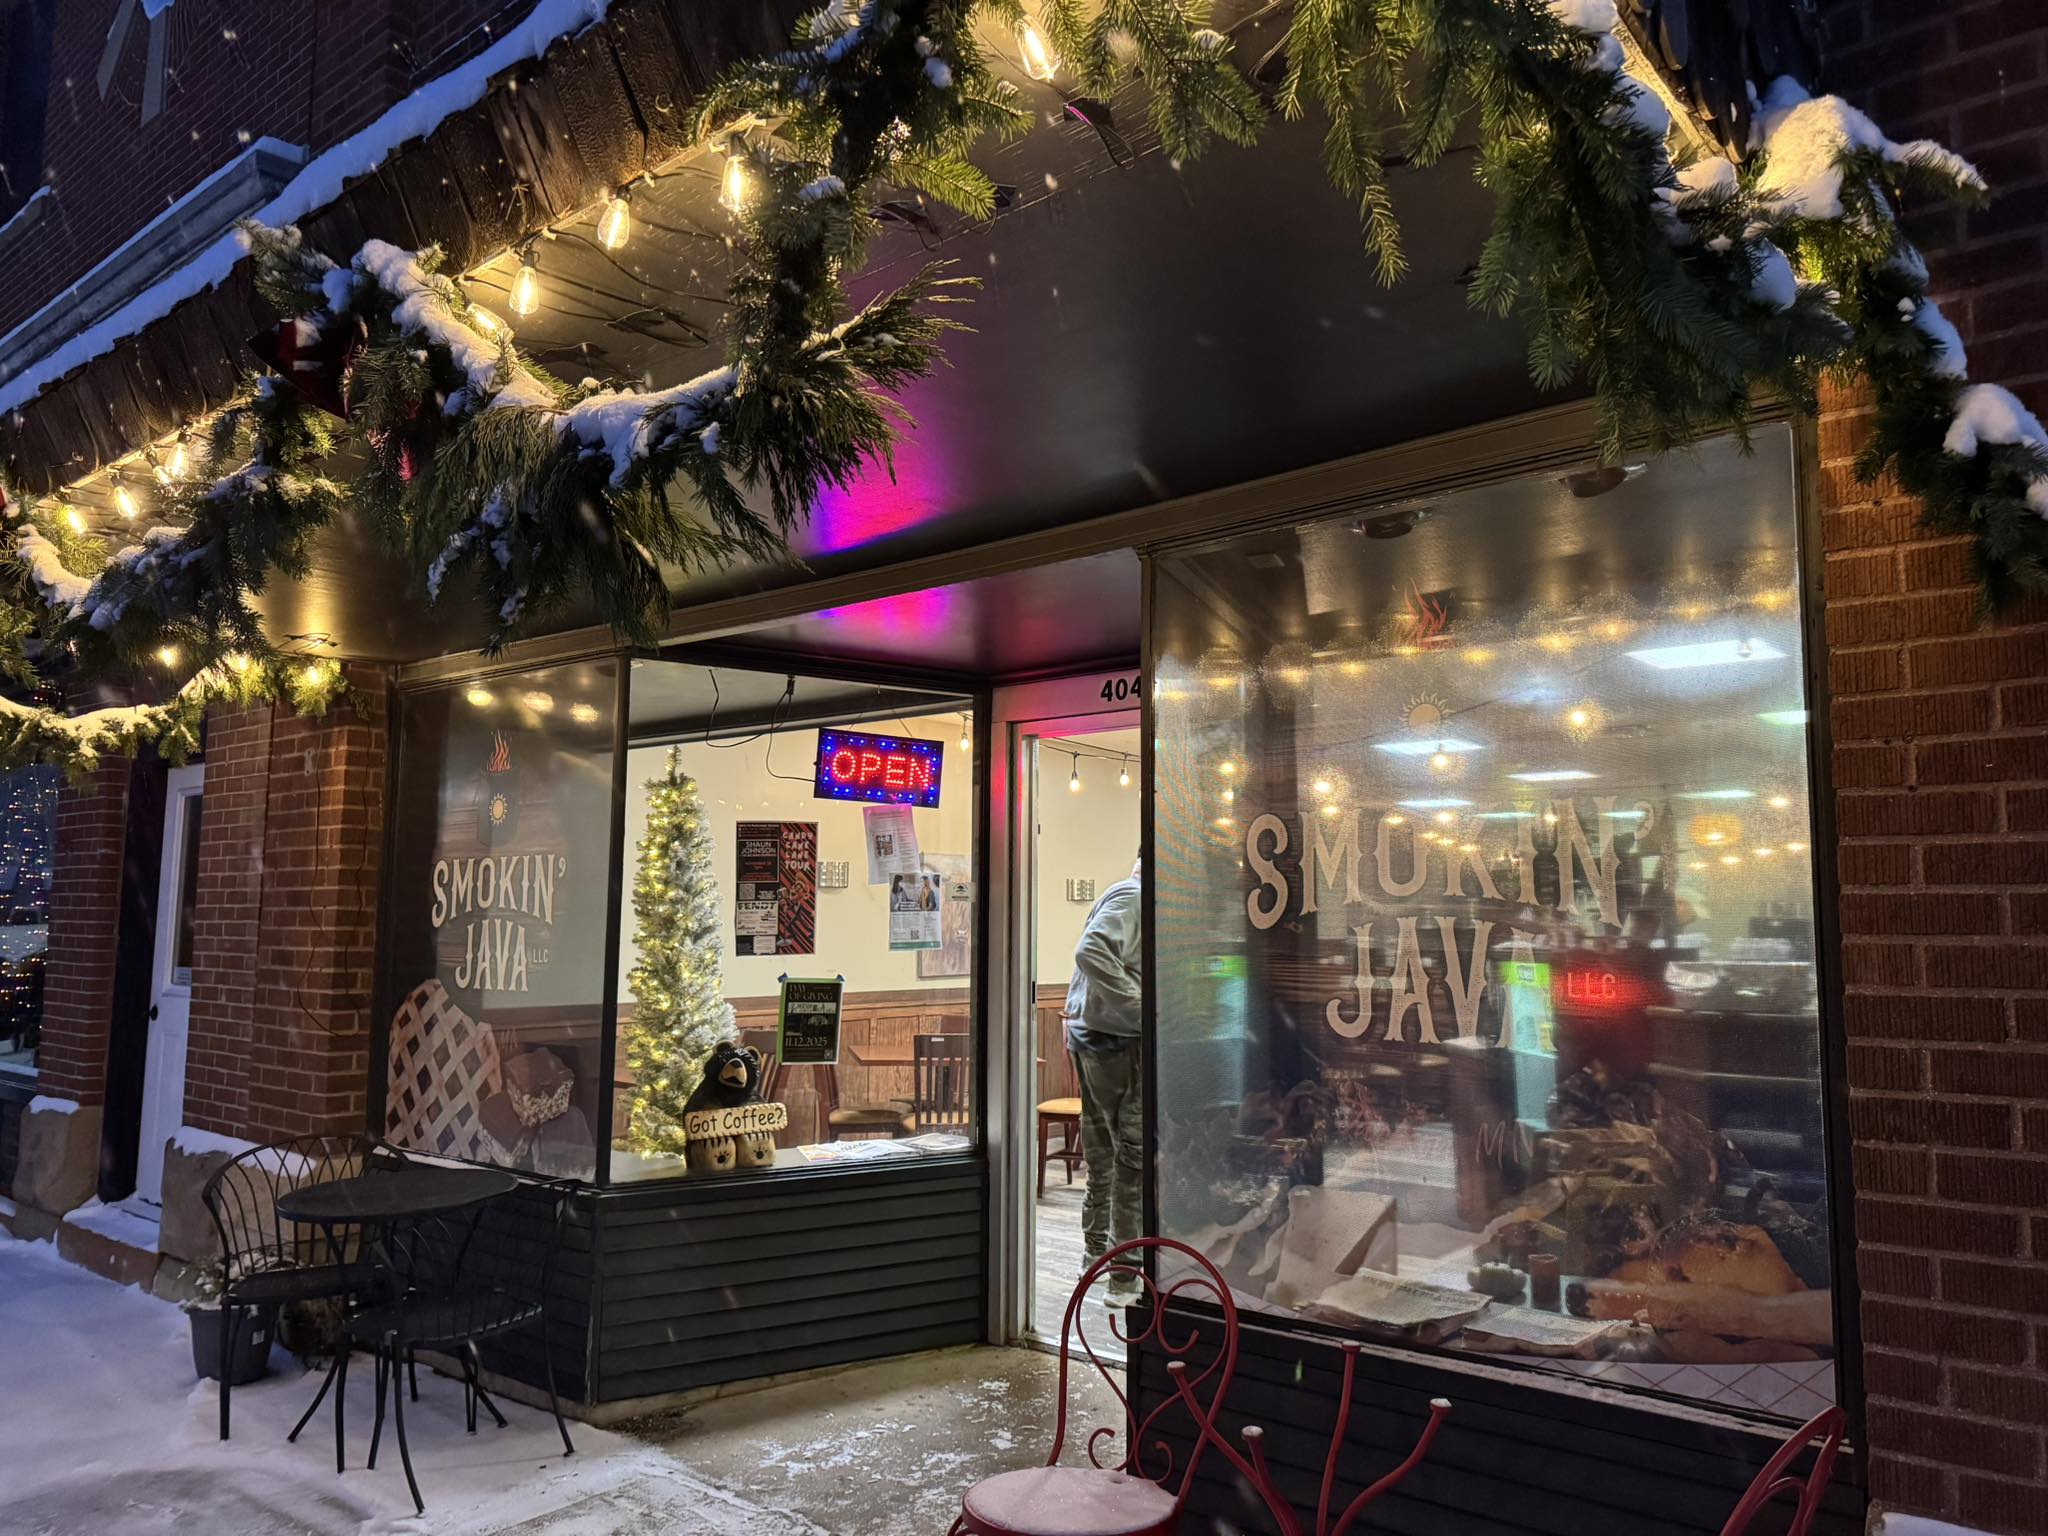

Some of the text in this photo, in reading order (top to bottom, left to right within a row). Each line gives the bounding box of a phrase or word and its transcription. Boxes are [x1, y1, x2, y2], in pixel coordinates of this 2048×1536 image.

[1100, 675, 1141, 702] 404
[832, 751, 931, 788] OPEN
[782, 831, 813, 840] CANDY
[785, 841, 809, 850] CANE
[741, 847, 776, 855] JOHNSON
[785, 850, 809, 859] LANE
[784, 860, 810, 871] TOUR
[432, 853, 567, 929] SMOKIN'
[737, 901, 777, 910] FENDT
[455, 918, 549, 992] JAVA LLC
[789, 984, 807, 993] DAY
[1326, 915, 1618, 1058] JAVA LLC
[803, 992, 833, 1000] GIVING
[689, 1107, 783, 1134] Got Coffee?
